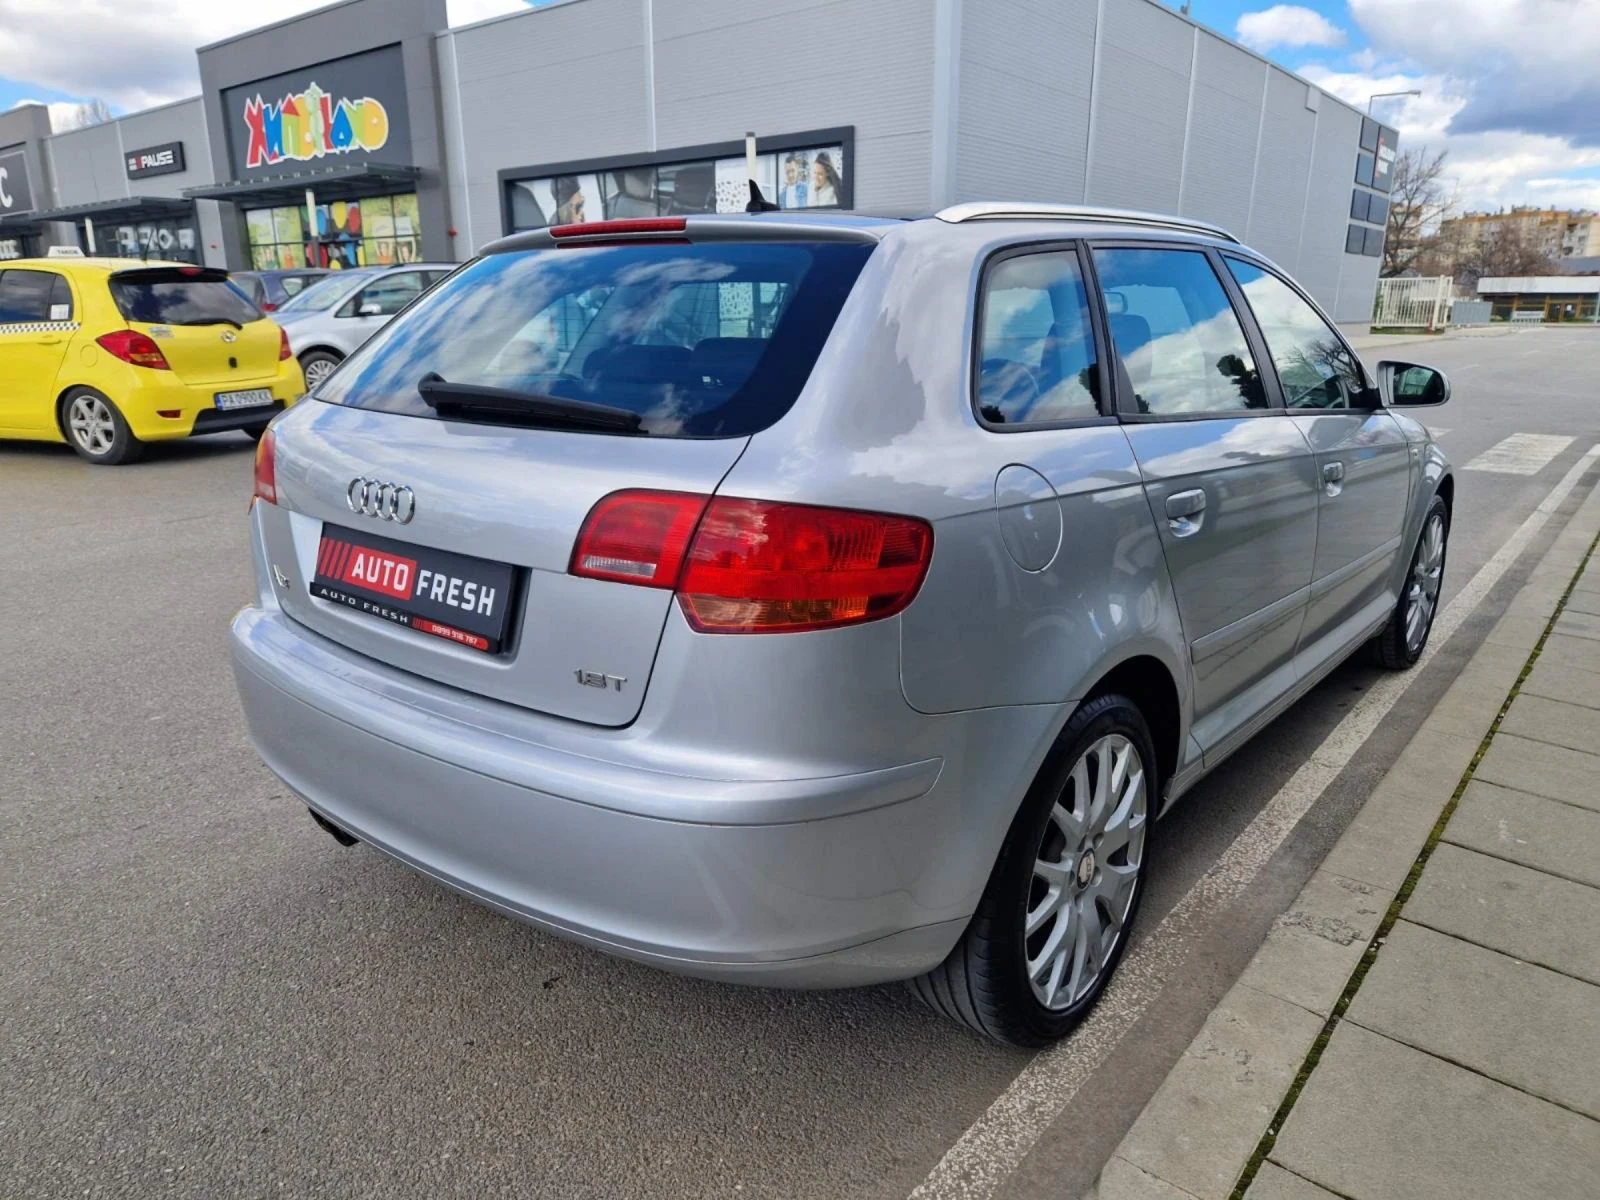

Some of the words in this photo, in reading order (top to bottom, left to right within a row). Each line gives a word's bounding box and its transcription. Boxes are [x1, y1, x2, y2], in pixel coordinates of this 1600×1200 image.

[141, 150, 174, 169] PAUSE
[351, 553, 409, 591] AUTO
[416, 569, 496, 617] FRESH
[320, 588, 357, 605] AUTO
[363, 602, 409, 624] FRESH
